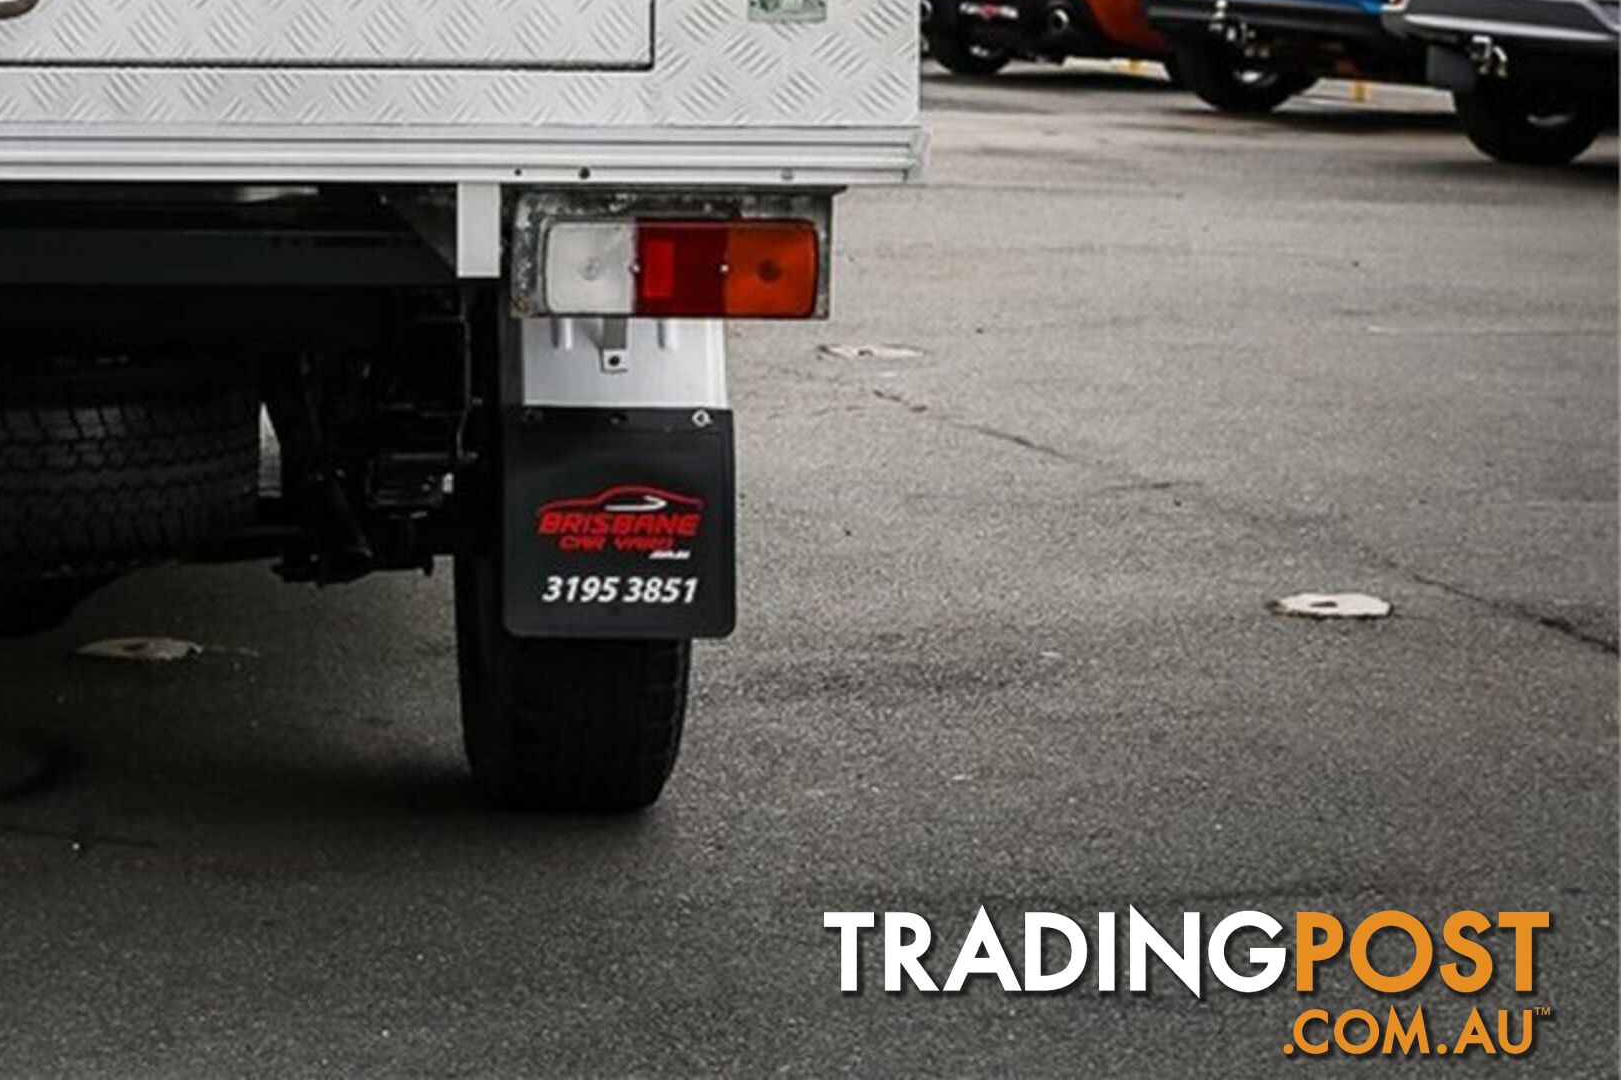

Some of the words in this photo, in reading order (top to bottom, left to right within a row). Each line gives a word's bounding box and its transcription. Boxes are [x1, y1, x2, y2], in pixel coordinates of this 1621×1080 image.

[539, 512, 702, 536] BRISBANE
[541, 575, 620, 603] 3195
[622, 575, 698, 603] 3851
